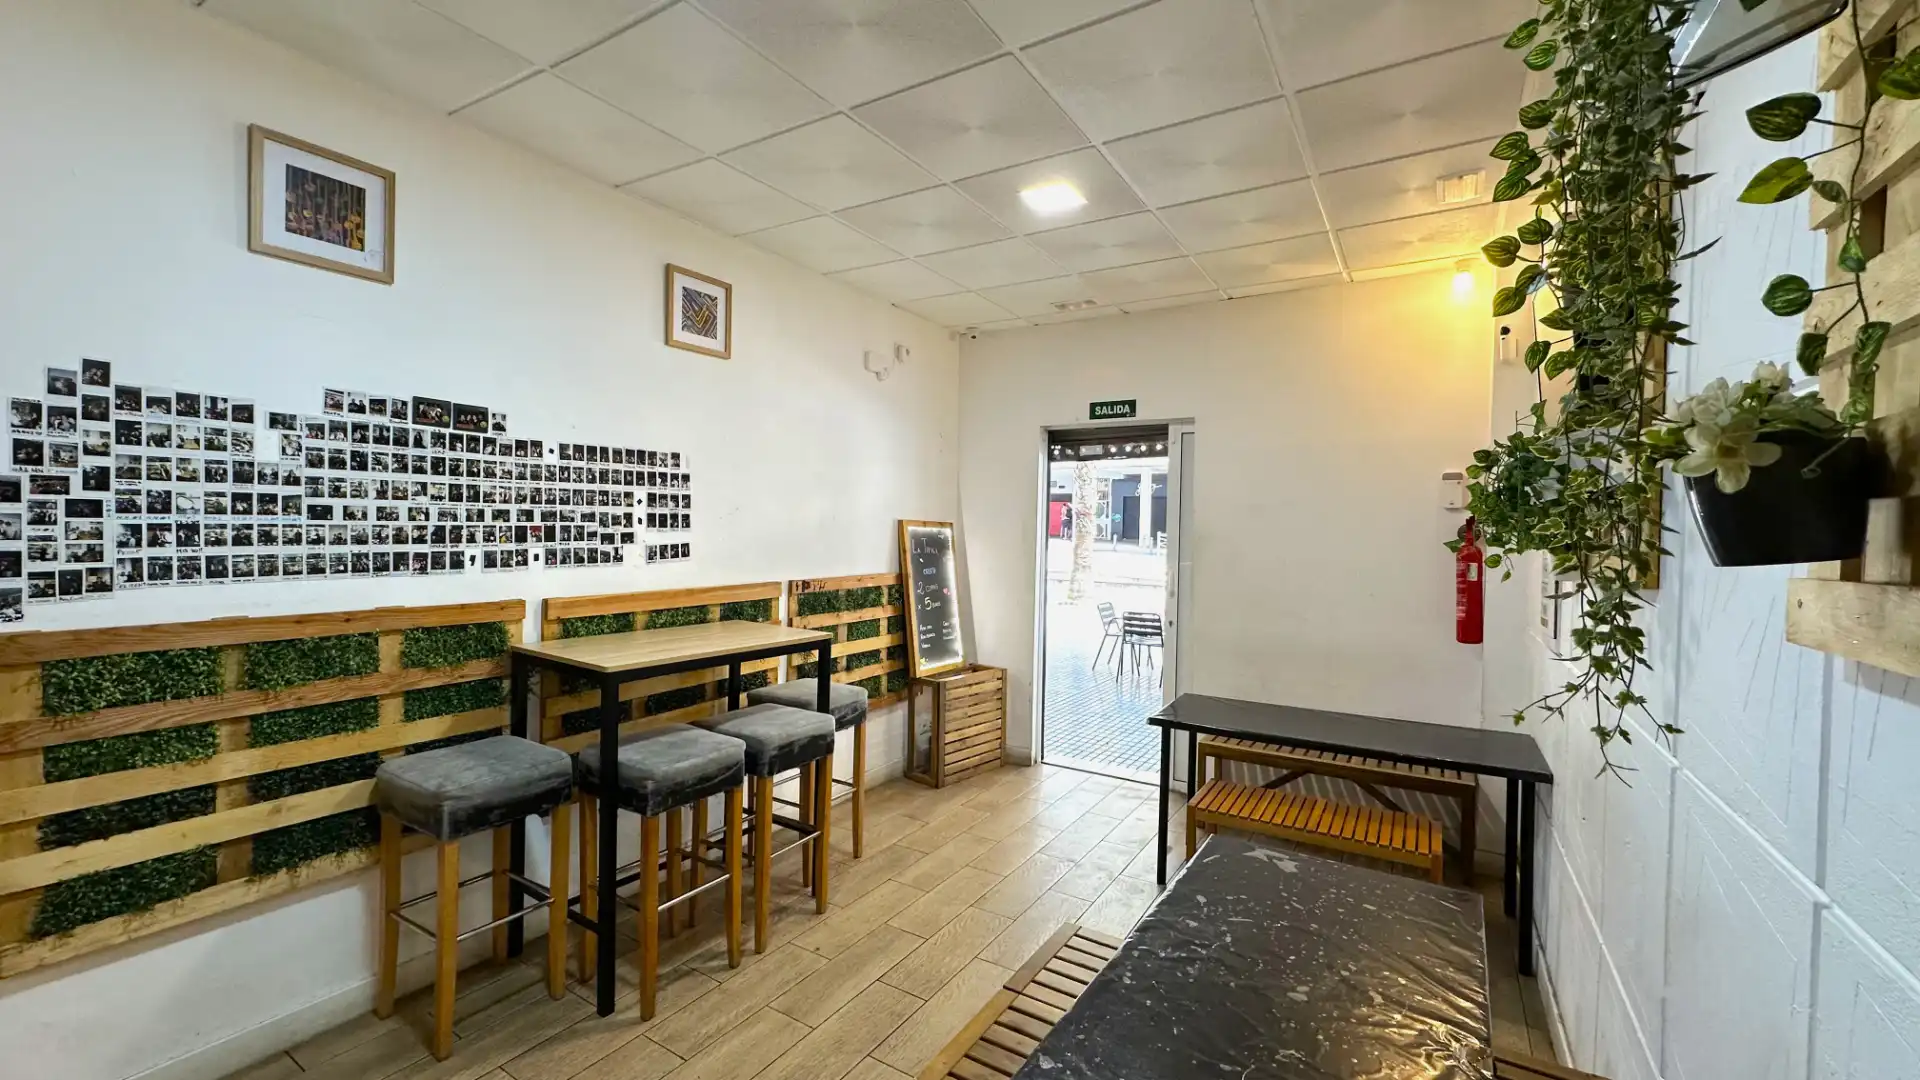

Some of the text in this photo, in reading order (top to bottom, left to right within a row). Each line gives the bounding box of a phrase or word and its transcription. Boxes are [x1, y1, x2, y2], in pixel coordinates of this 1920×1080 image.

[1095, 404, 1131, 416] SALIDA
[917, 581, 924, 595] 2
[924, 596, 932, 610] 5
